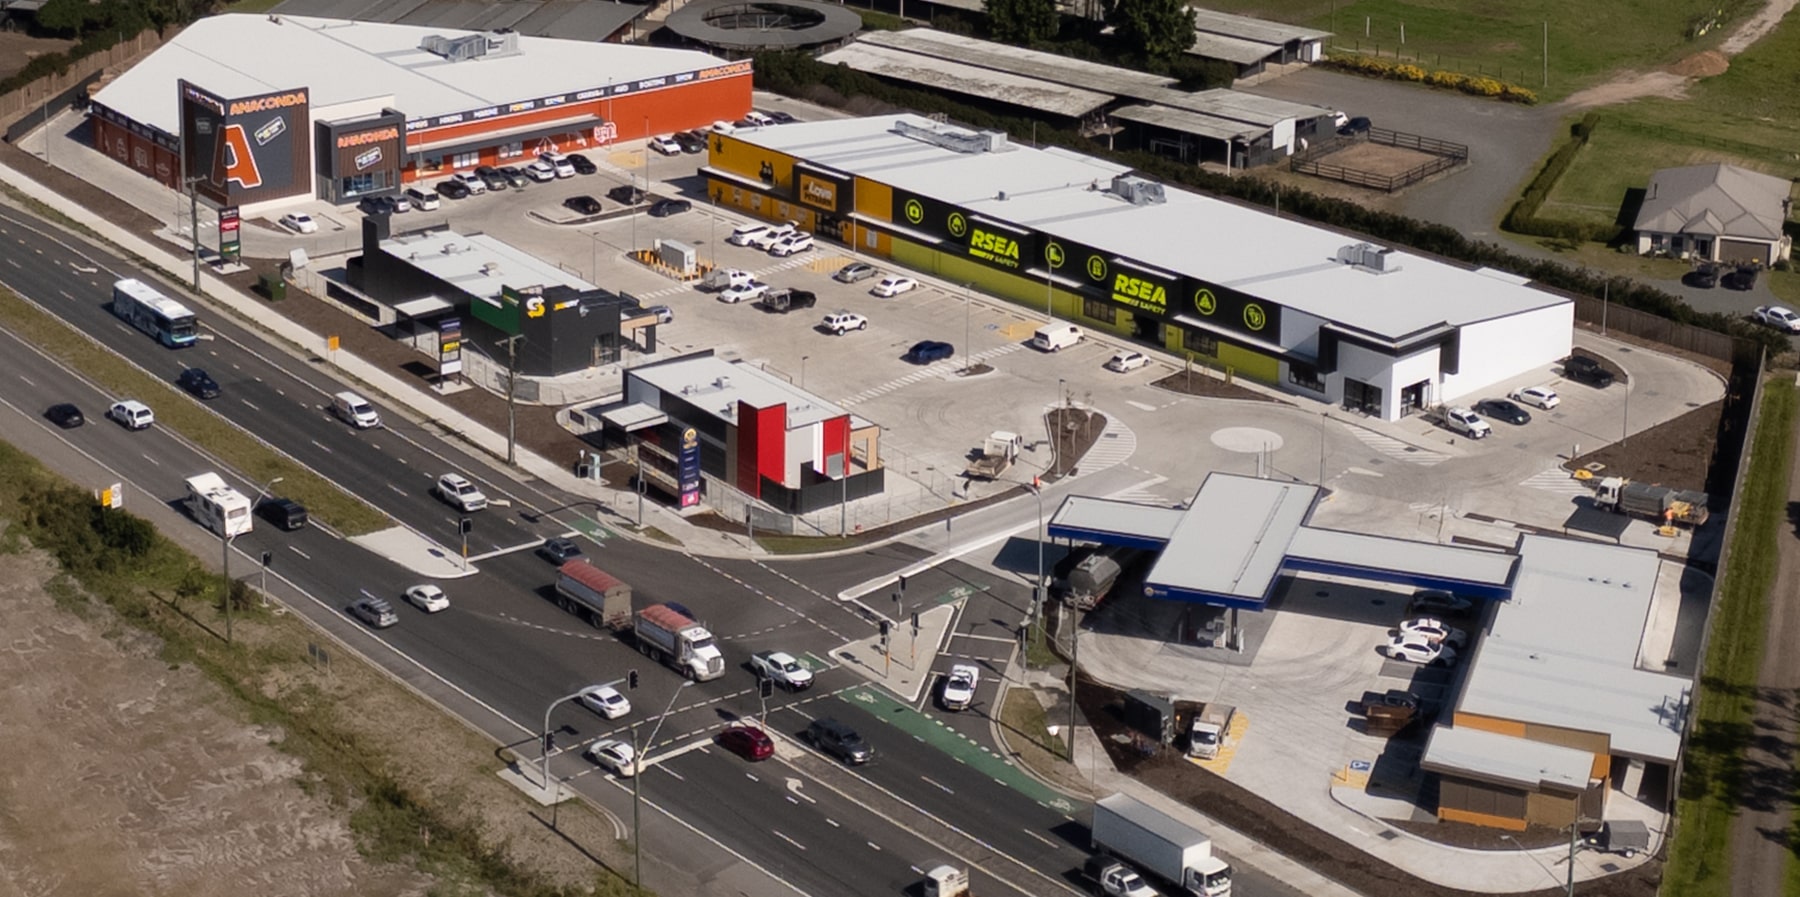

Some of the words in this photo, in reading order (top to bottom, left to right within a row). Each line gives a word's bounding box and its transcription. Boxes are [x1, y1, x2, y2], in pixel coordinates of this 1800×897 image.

[230, 92, 307, 116] ANACONDA
[337, 127, 399, 149] ANACONDA
[211, 123, 262, 189] A
[970, 228, 1019, 260] RSEA
[1113, 273, 1166, 306] RSEA
[1140, 301, 1166, 316] SAFETY
